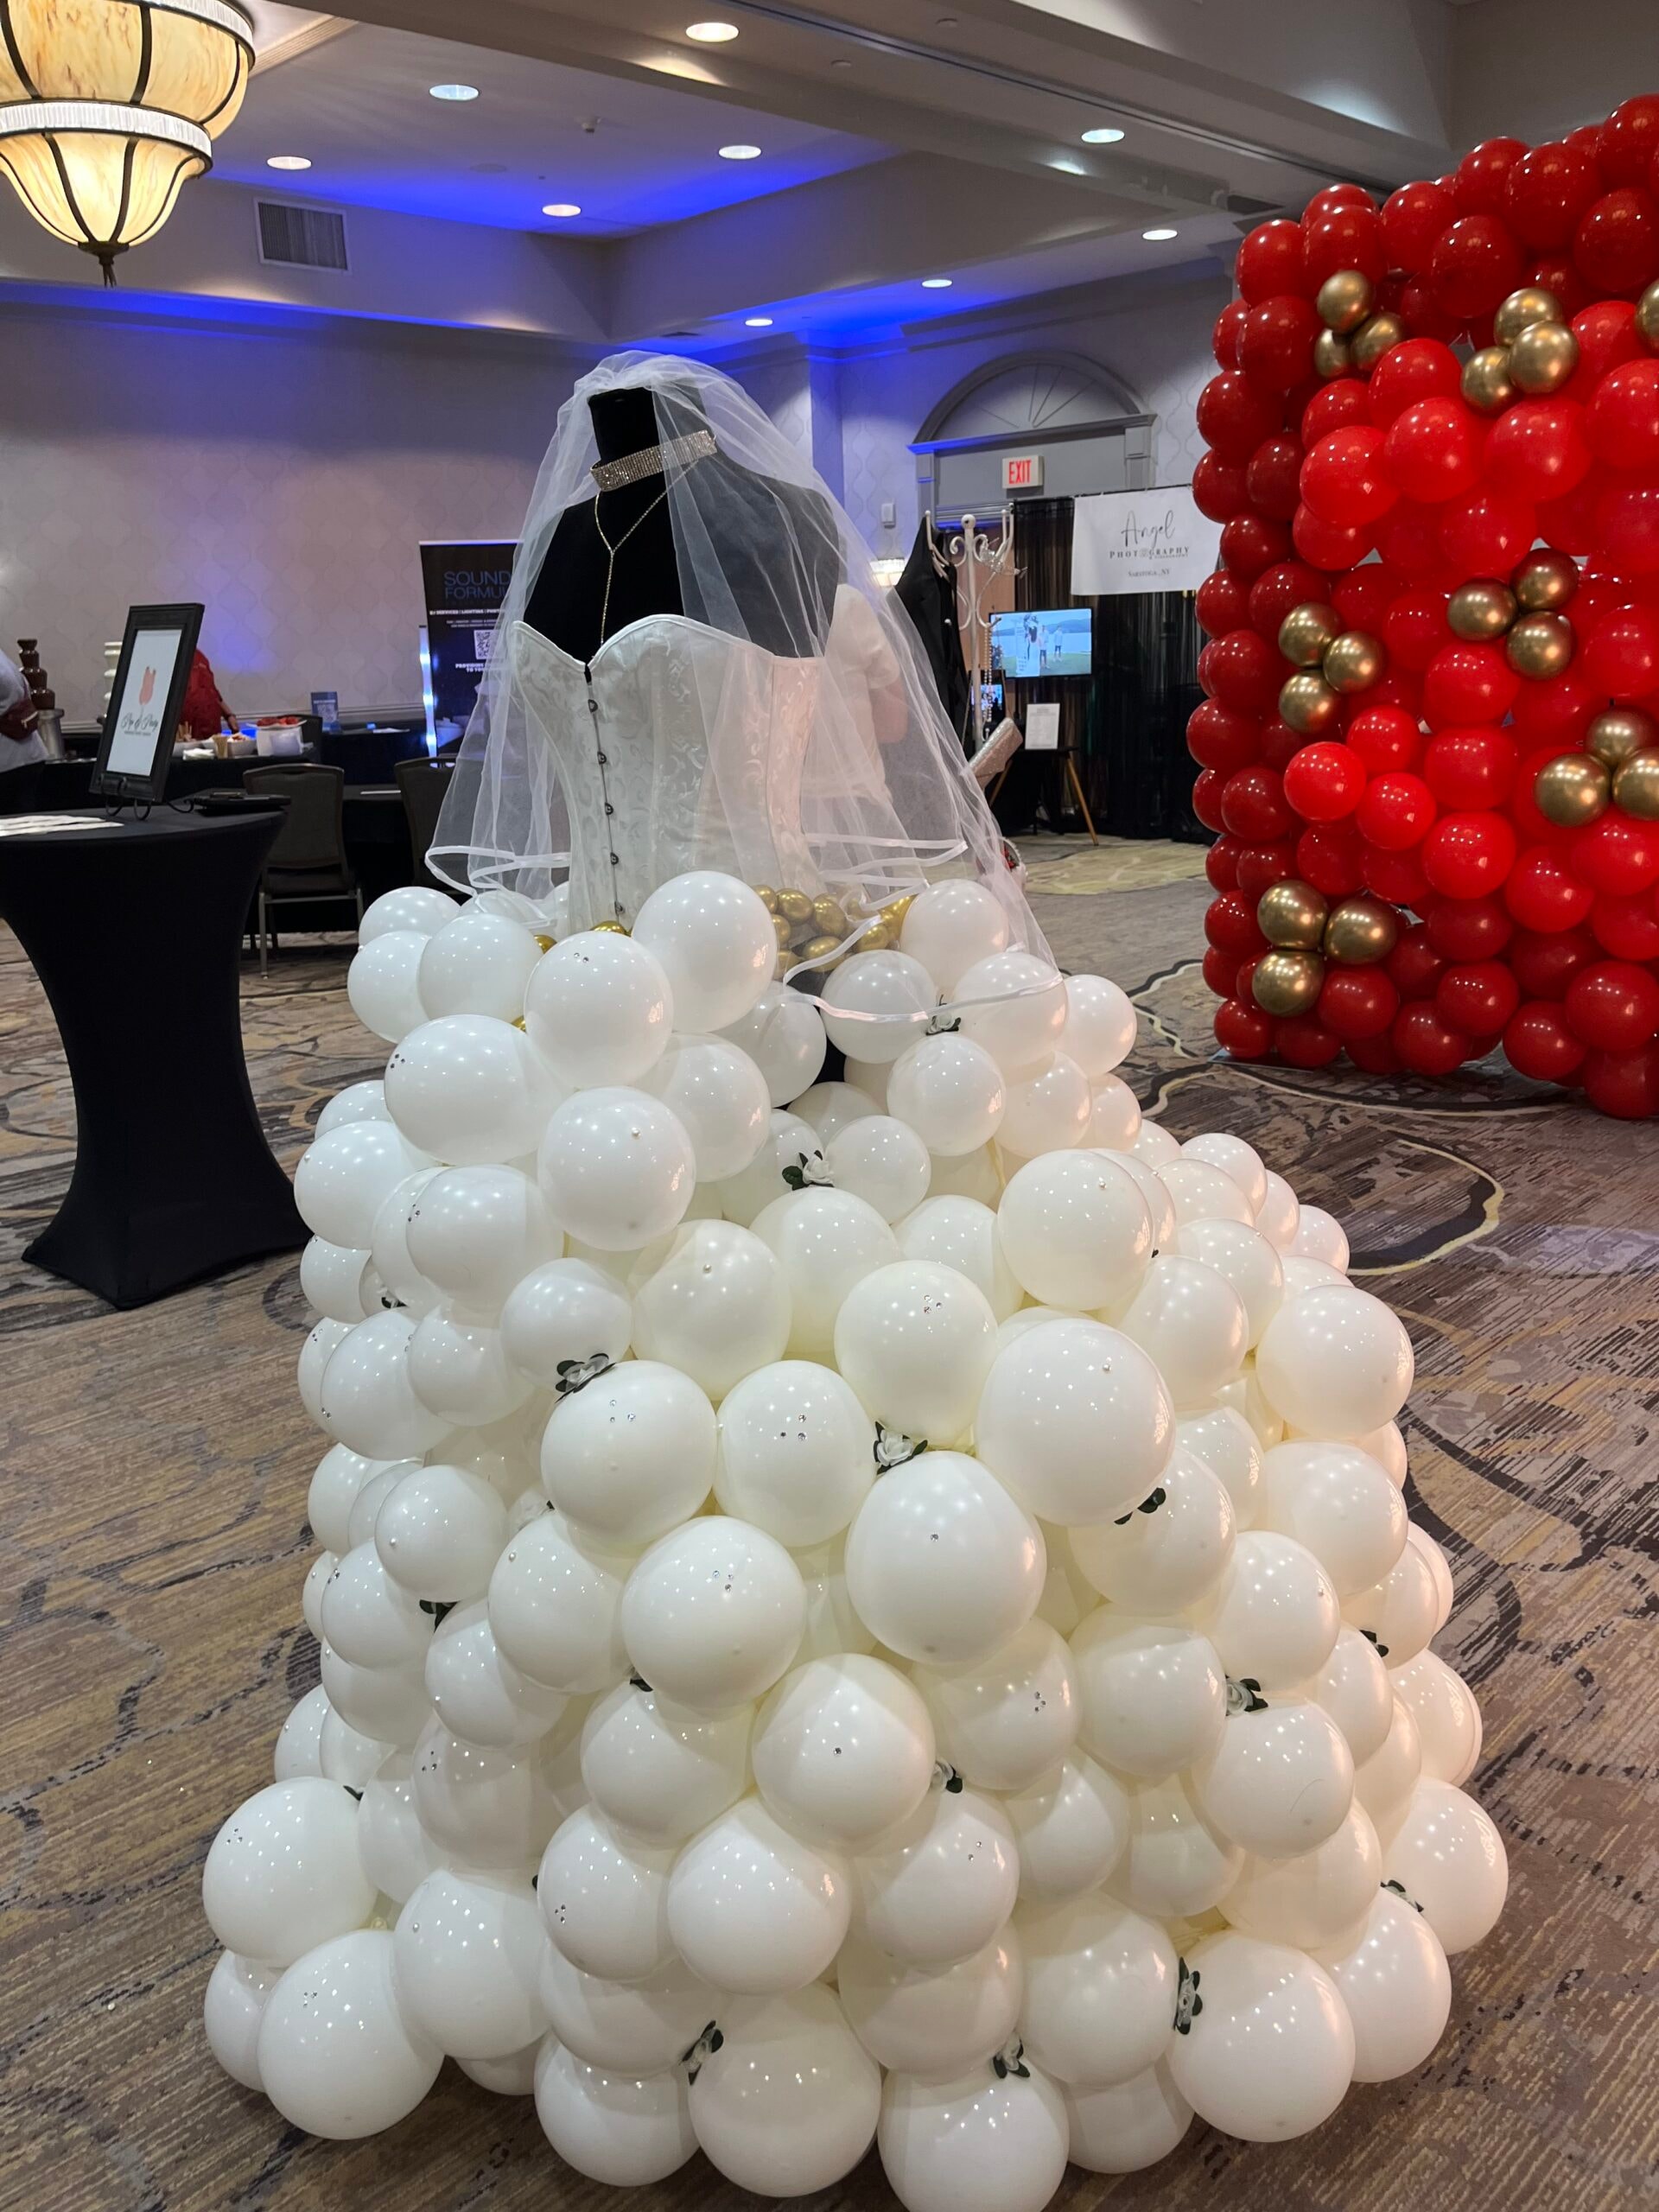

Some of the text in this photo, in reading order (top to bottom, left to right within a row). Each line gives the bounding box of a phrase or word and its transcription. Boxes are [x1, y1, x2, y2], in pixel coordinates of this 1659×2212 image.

[1008, 460, 1031, 484] EXIT
[1121, 510, 1176, 549] Angel
[443, 570, 512, 586] SOUND
